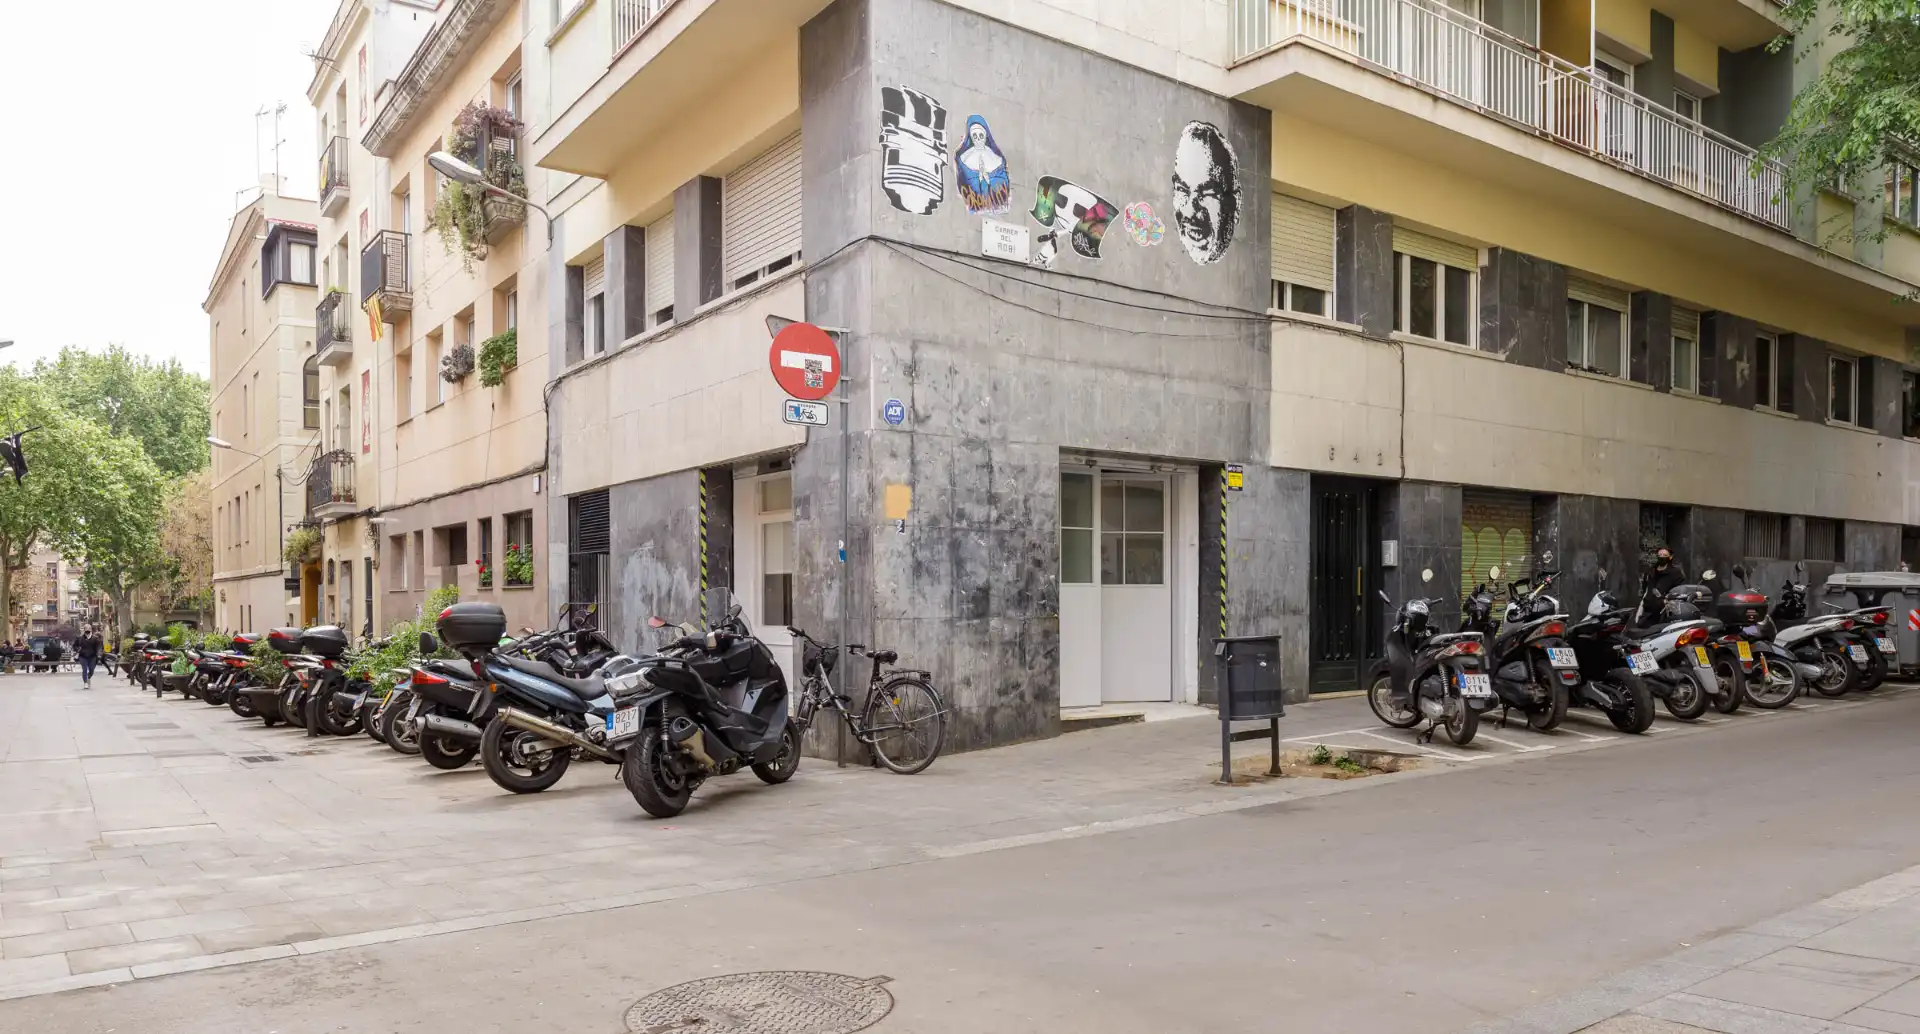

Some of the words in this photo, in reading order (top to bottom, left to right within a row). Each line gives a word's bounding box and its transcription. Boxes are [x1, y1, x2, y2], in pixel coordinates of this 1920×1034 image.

[995, 226, 1018, 236] CARRER
[1001, 234, 1012, 242] DEL
[615, 709, 637, 723] 8217
[615, 721, 631, 735] LJP
